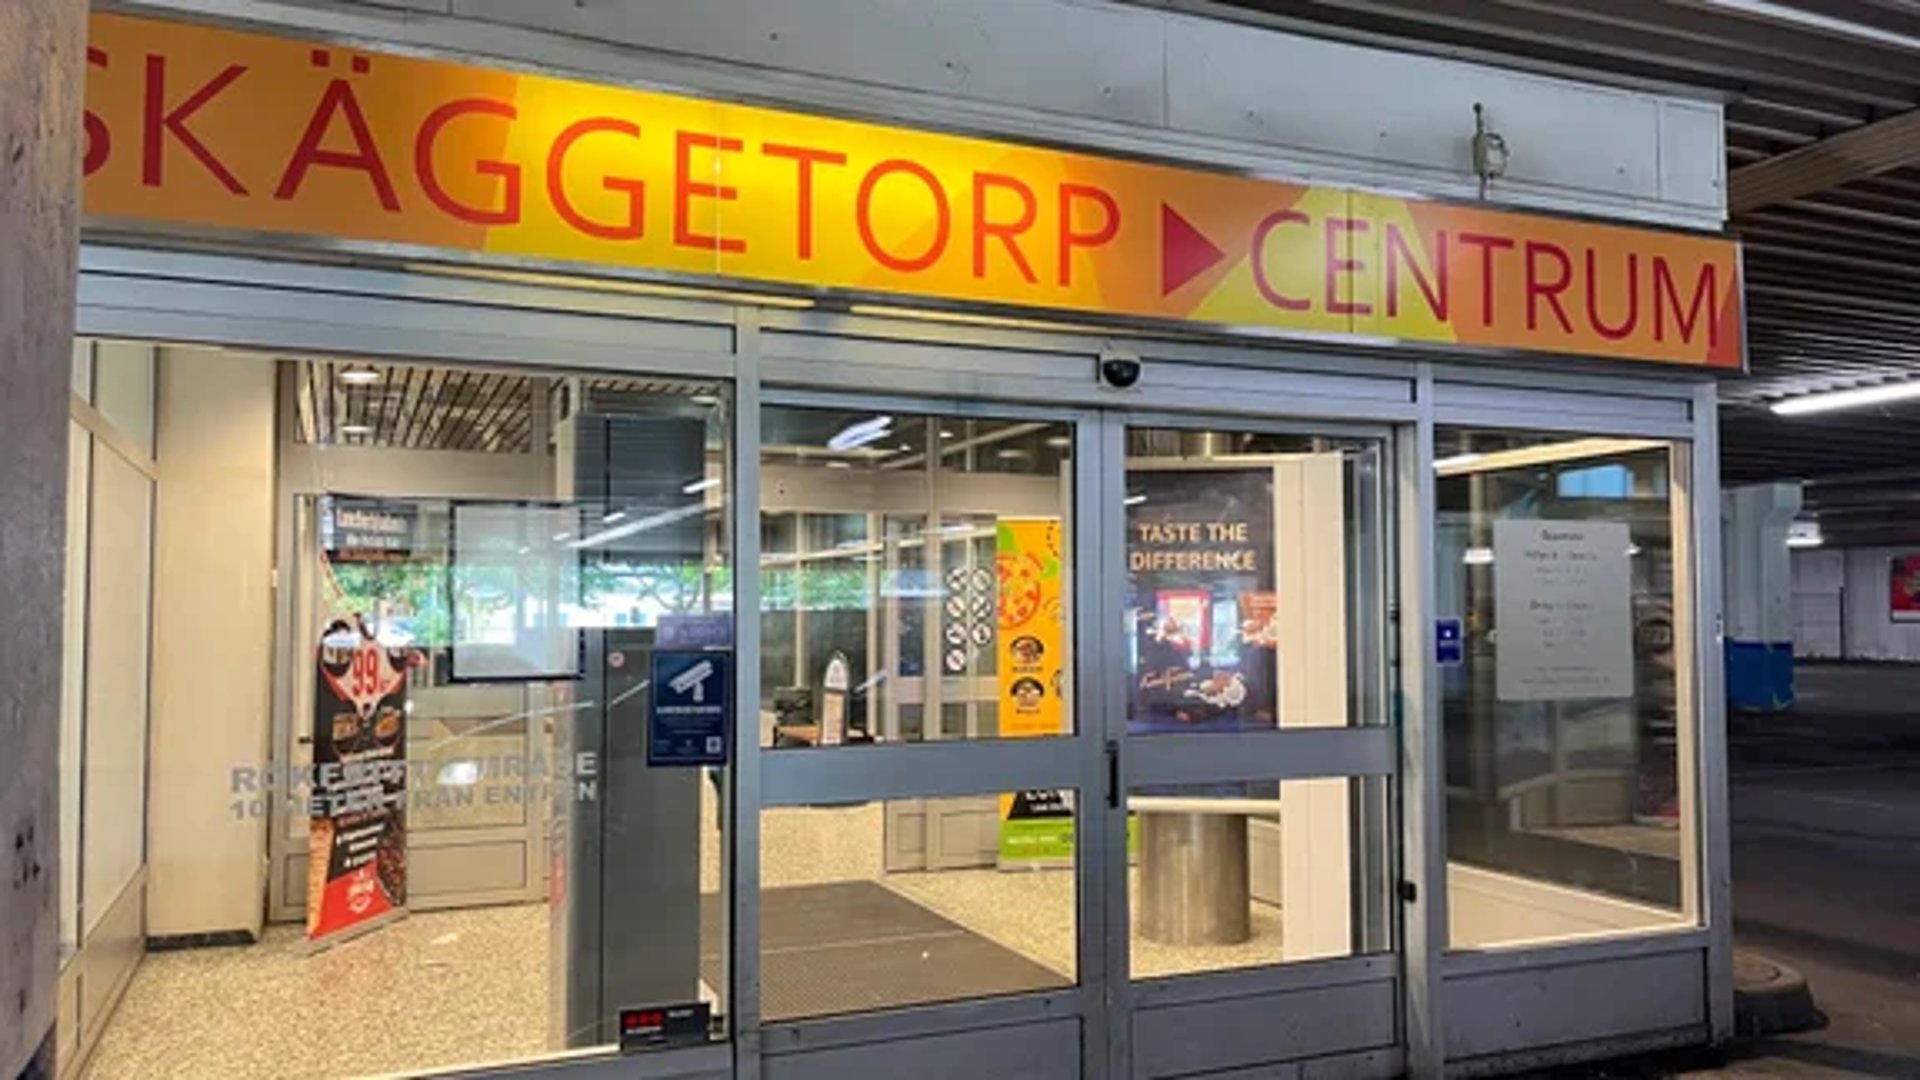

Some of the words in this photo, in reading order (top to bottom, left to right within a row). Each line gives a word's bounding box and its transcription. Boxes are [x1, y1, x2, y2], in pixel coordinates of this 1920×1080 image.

[1250, 209, 1719, 348] CENTRUM
[1138, 522, 1200, 542] TASTE
[1207, 522, 1248, 541] THE
[1130, 550, 1256, 571] DIFFERENCE
[352, 647, 378, 696] 99
